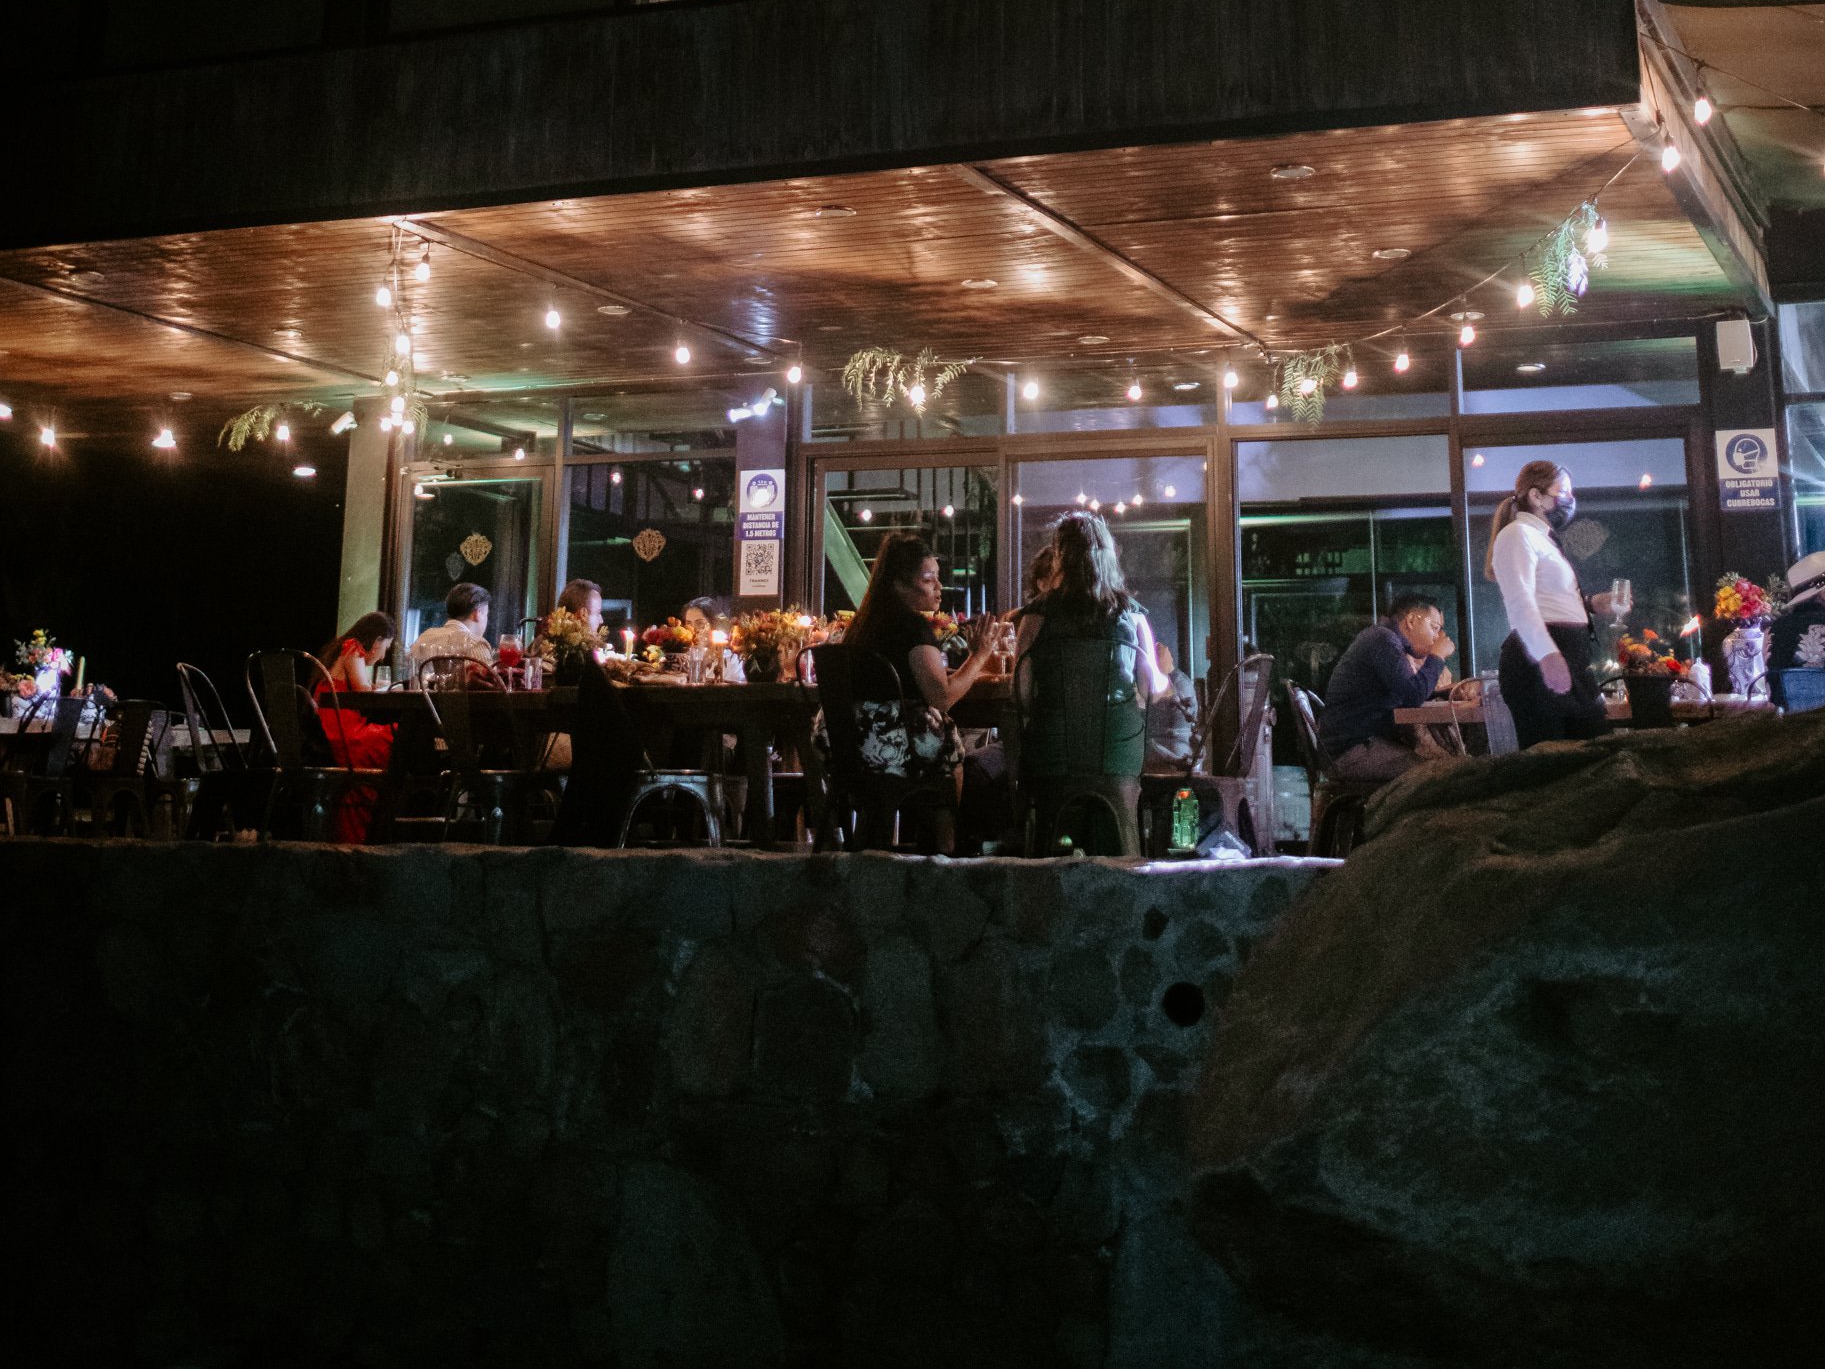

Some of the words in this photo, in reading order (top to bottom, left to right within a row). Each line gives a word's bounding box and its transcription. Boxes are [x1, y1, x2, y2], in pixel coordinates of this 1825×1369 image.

[1725, 479, 1773, 488] OBLIGATORIO
[1740, 489, 1760, 497] USAR
[1726, 498, 1775, 507] CUBREBOCAS
